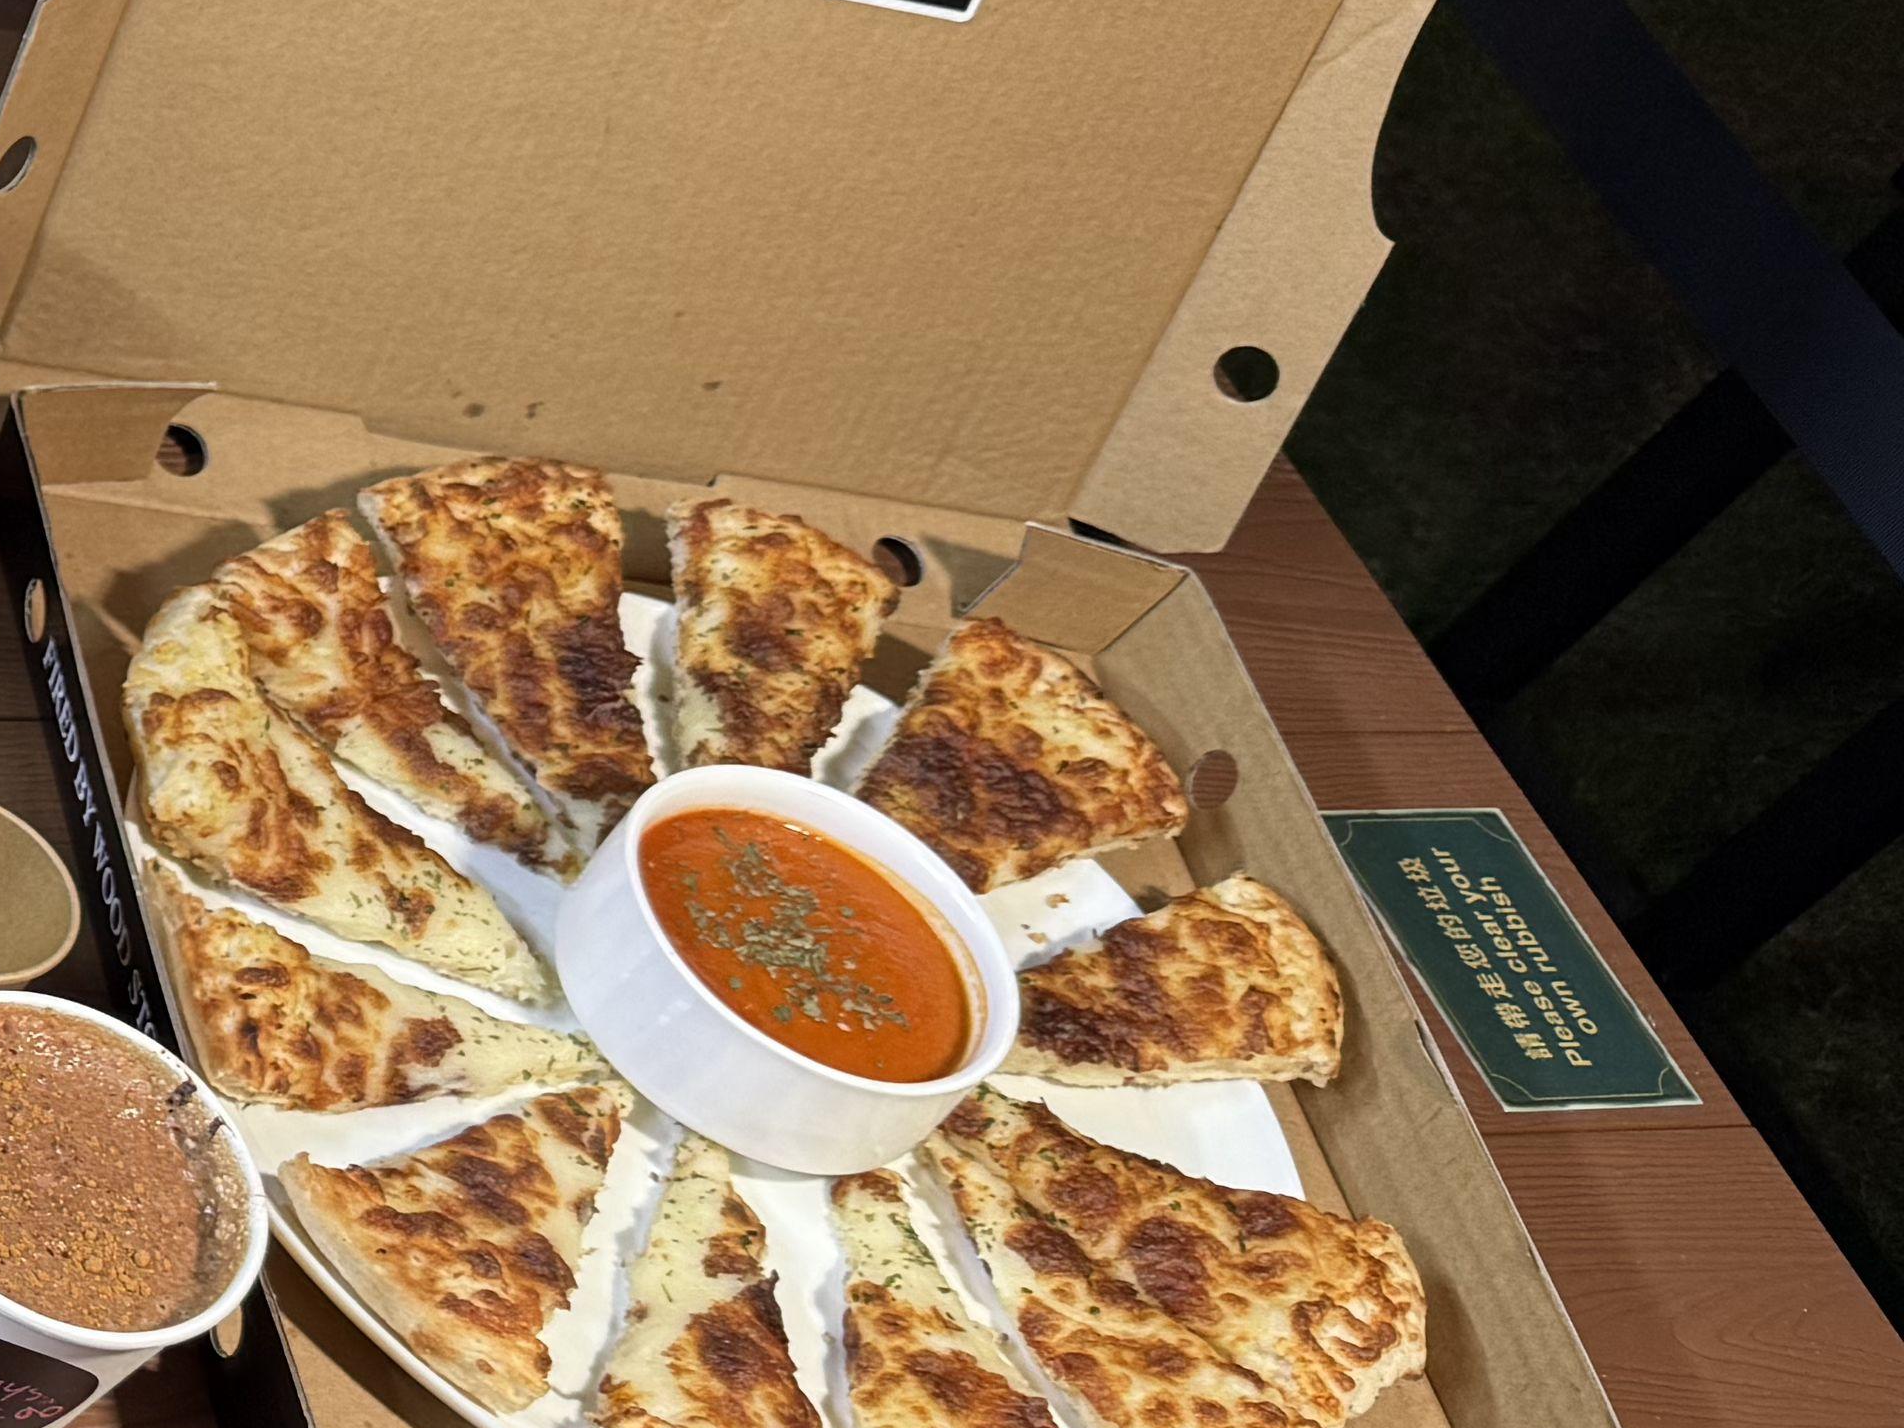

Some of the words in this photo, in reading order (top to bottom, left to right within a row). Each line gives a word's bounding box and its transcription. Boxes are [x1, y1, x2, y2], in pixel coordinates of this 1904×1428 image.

[43, 636, 80, 762] FIRED
[74, 757, 97, 827] BY
[93, 821, 131, 966] WOOD
[1430, 846, 1488, 904] your
[1473, 909, 1528, 974] clear
[1479, 875, 1558, 974] rubbish
[1523, 978, 1593, 1068] Please
[1551, 980, 1599, 1036] own
